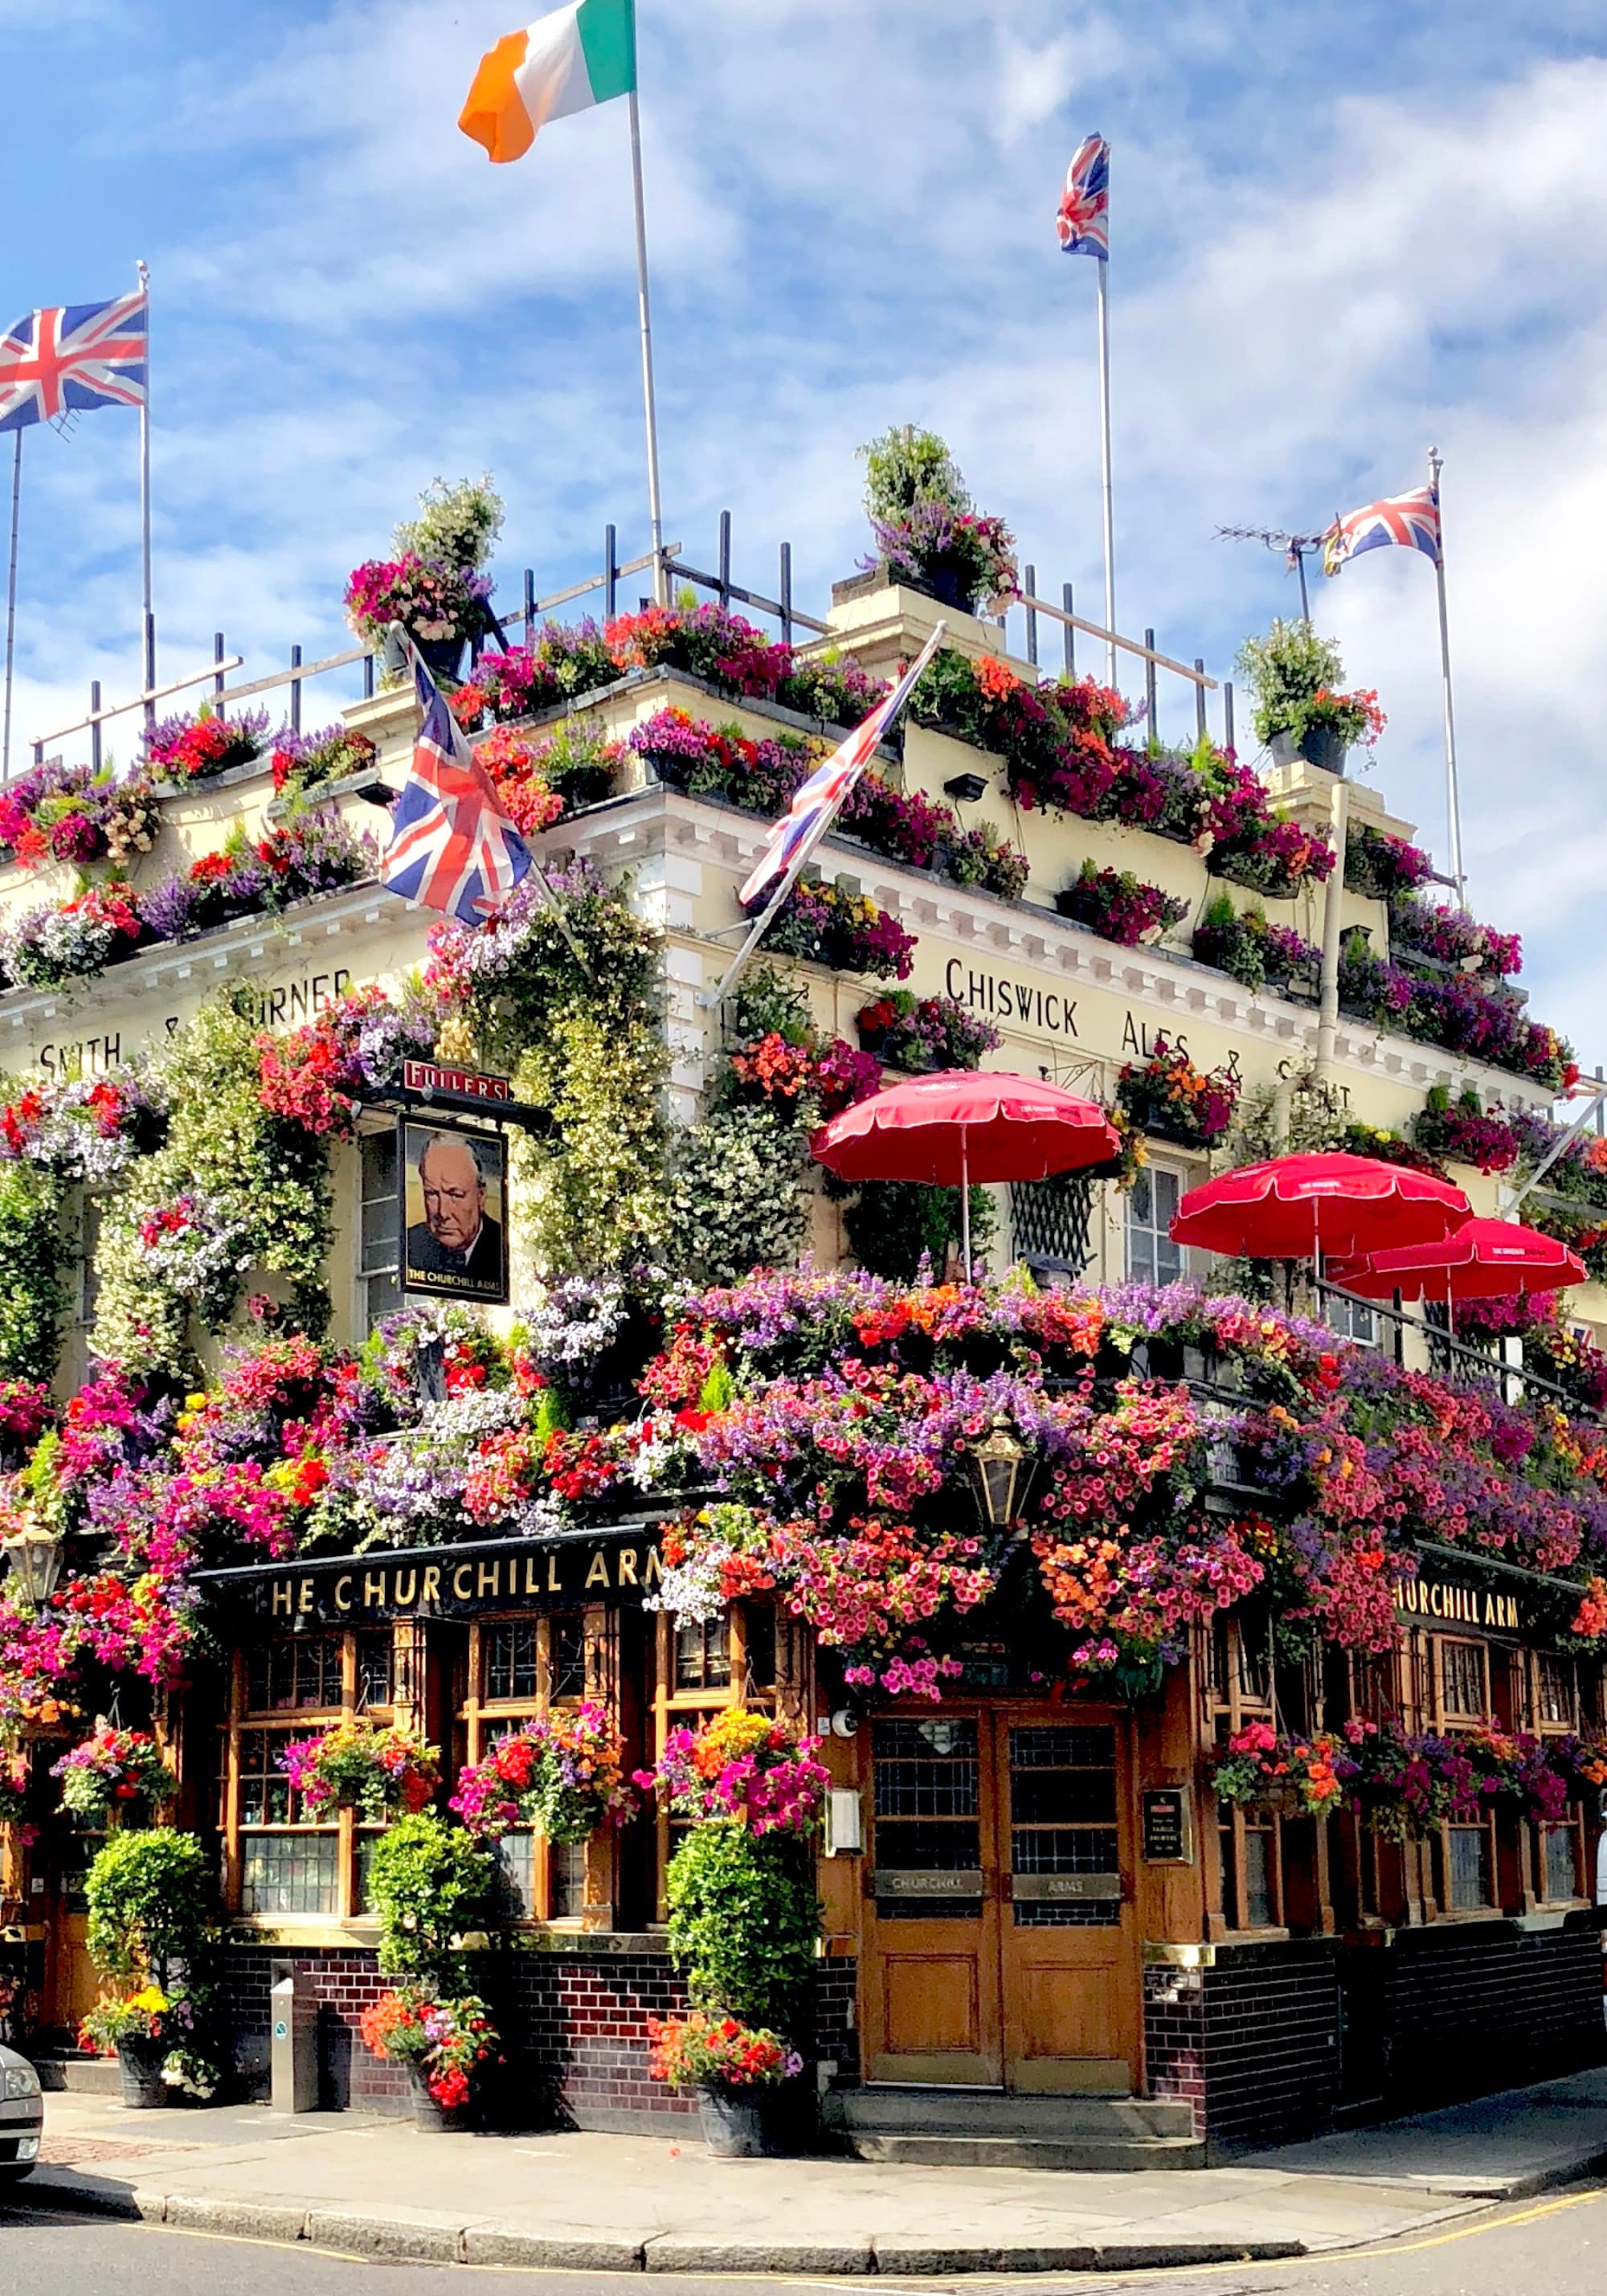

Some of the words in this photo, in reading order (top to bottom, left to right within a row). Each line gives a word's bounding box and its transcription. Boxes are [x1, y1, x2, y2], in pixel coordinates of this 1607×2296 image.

[946, 958, 1078, 1037] CHISWICK
[408, 1269, 426, 1280] THE
[427, 1271, 476, 1288] CHURCHILL
[270, 1578, 315, 1616] HE
[334, 1555, 562, 1610] CHURCHILL
[584, 1549, 673, 1589] ARM
[1392, 1575, 1480, 1624] HURCHILL
[1485, 1593, 1519, 1628] ARM
[1047, 1881, 1083, 1893] ARMS
